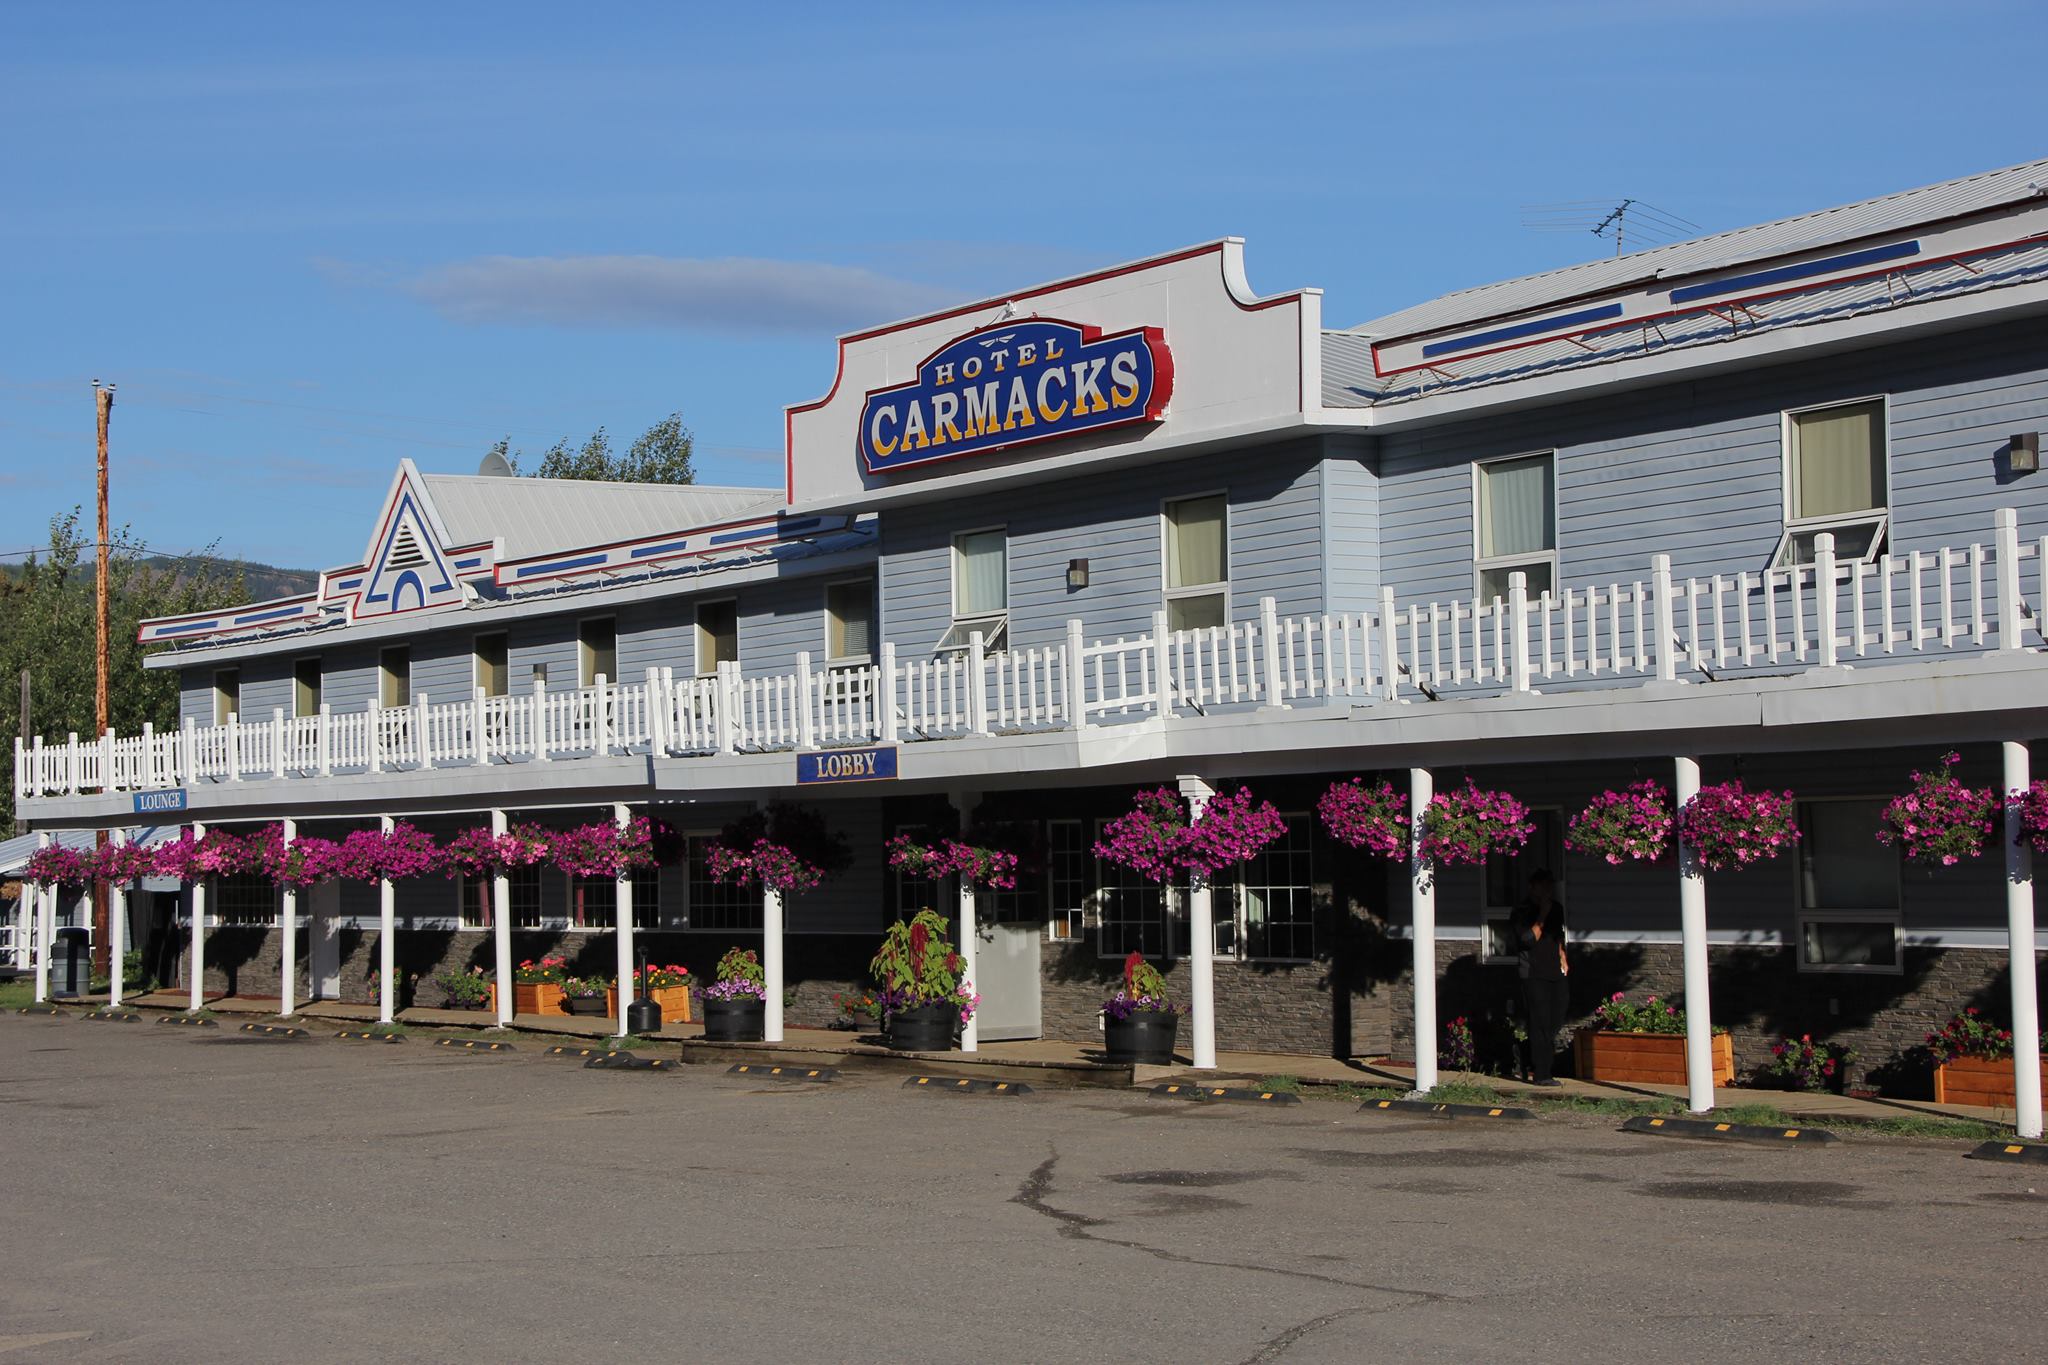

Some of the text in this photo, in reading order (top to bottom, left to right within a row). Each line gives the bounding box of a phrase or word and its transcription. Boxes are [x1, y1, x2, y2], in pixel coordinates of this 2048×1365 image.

[935, 338, 1064, 387] HOTEL
[871, 350, 1139, 457] CARMACKS
[816, 752, 877, 778] LOBBY
[140, 792, 181, 810] LOUNGE
